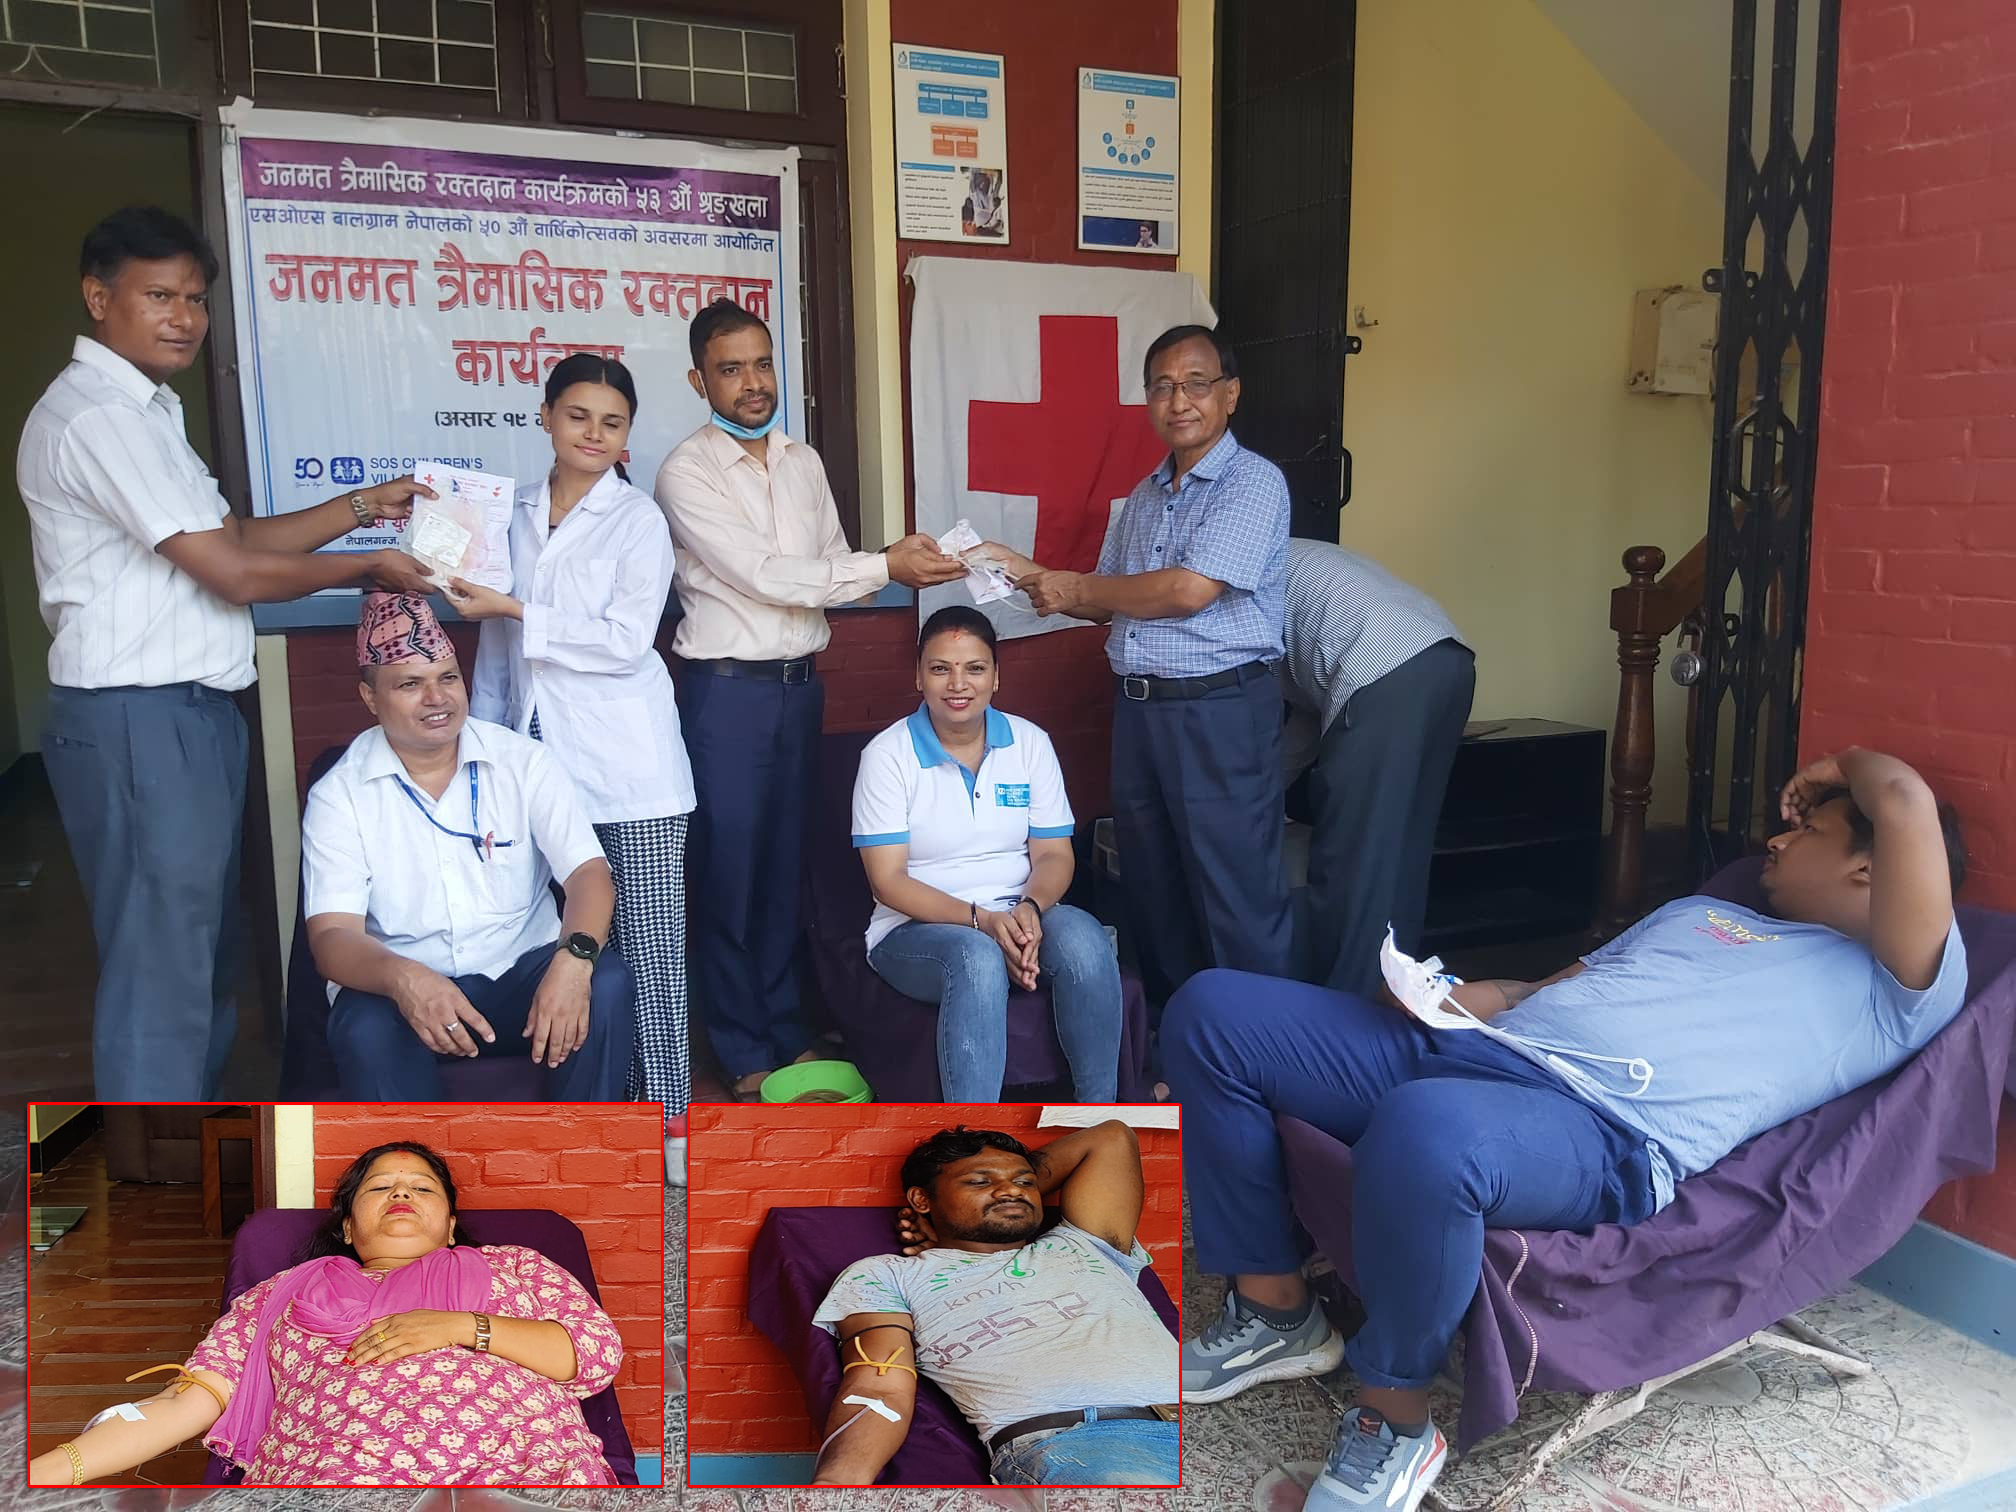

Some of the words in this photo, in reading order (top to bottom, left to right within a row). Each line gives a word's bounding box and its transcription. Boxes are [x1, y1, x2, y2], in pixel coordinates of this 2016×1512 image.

[258, 161, 333, 190] जनमत
[339, 157, 427, 193] त्रैमासिक
[433, 171, 516, 203] रक्तदान
[523, 174, 629, 208] कार्यक्रमको
[635, 187, 661, 216] ५३
[249, 204, 325, 225] एसओएस
[332, 211, 399, 231] बालग्राम
[404, 210, 473, 233] नेपालको
[478, 219, 501, 237] ५०
[534, 219, 638, 243] वार्षिकोत्सवको
[643, 229, 708, 247] अवसरमा
[713, 231, 775, 253] आयोजित
[265, 253, 419, 309] जनमत
[434, 241, 607, 313] त्रैमासिक
[435, 411, 498, 428] (असार
[503, 412, 527, 427] १९
[294, 457, 324, 480] 50
[370, 457, 399, 469] SOS
[944, 1280, 1026, 1312] km/h
